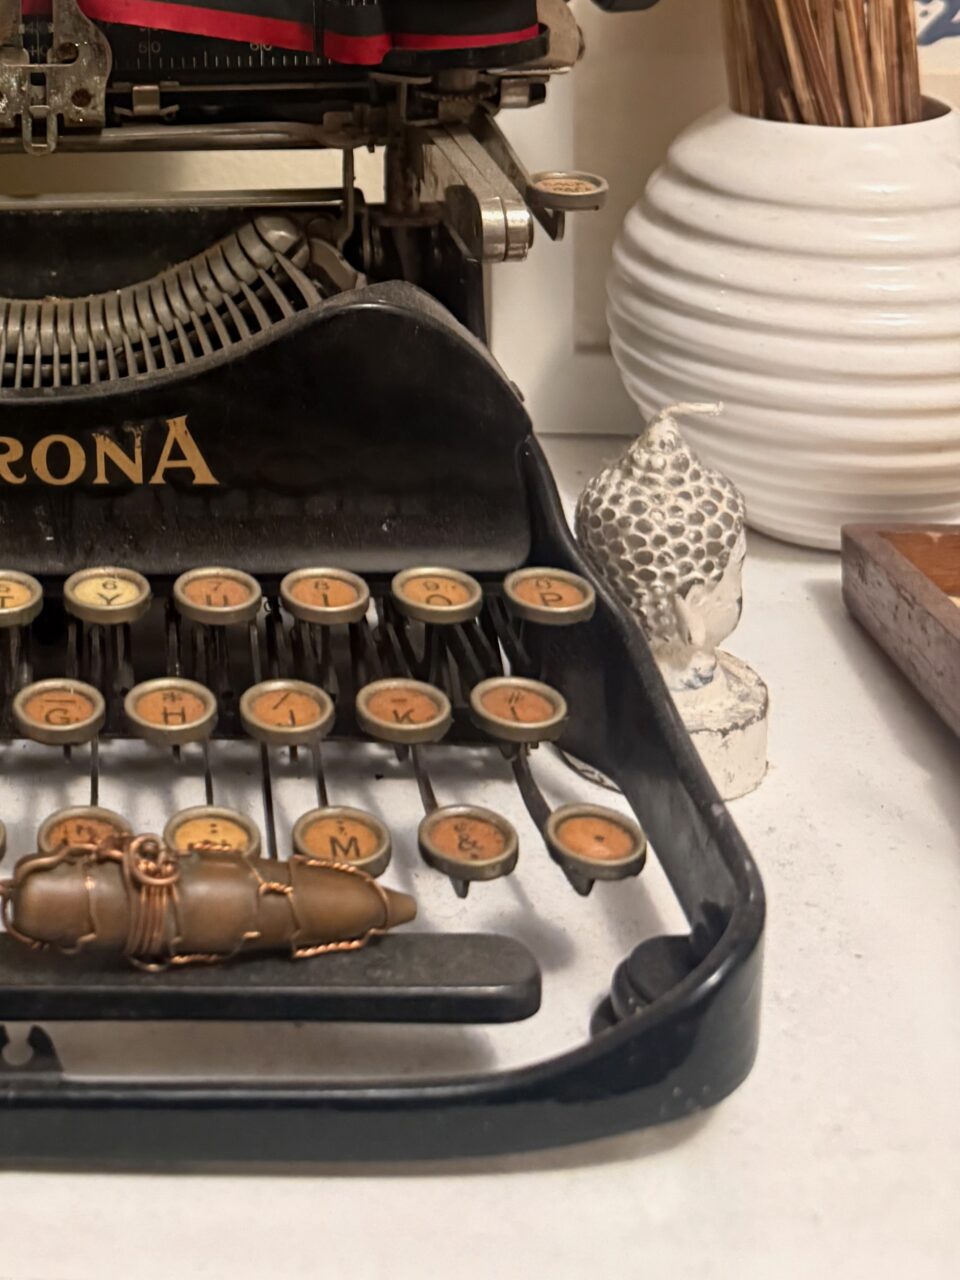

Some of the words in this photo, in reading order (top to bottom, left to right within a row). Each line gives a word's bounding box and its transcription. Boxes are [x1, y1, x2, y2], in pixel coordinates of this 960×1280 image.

[97, 592, 122, 607] Y
[539, 592, 563, 607] P
[45, 708, 71, 726] G
[163, 706, 186, 725] H
[392, 708, 416, 724] K
[329, 836, 362, 858] M
